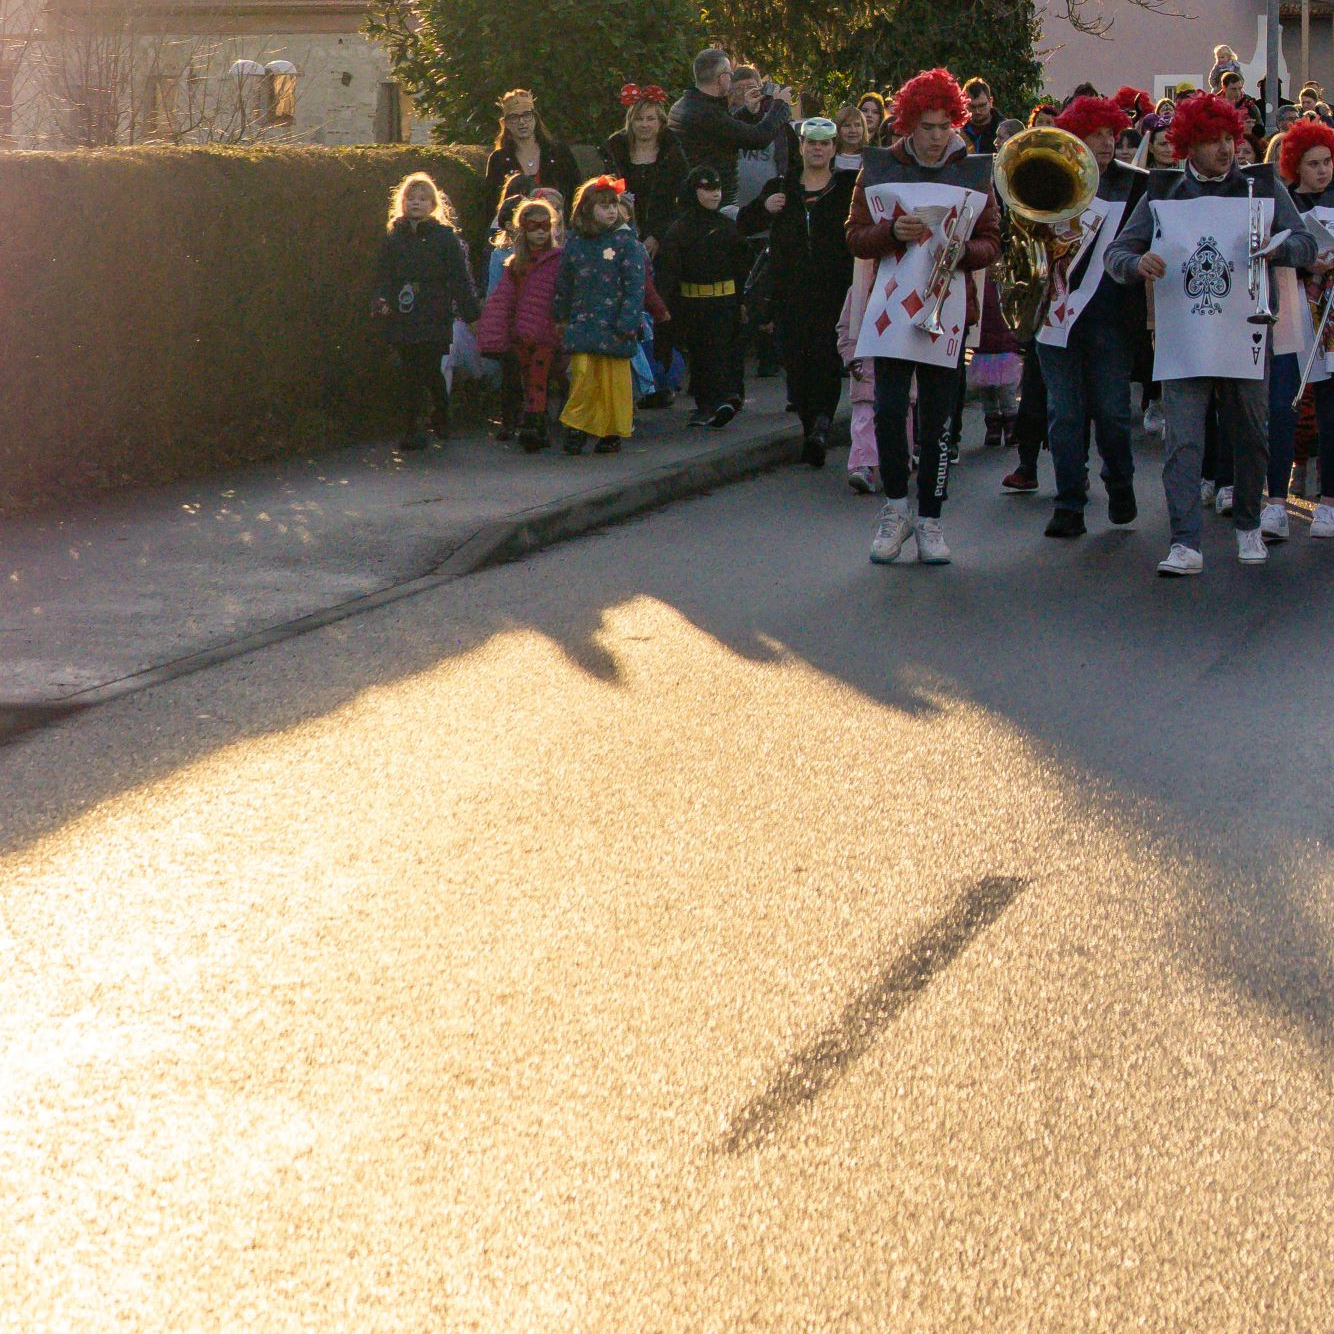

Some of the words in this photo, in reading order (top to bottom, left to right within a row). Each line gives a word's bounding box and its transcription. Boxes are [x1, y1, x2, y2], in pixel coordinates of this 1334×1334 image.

[870, 195, 885, 213] 10
[946, 338, 958, 357] 10
[1252, 347, 1261, 365] A
